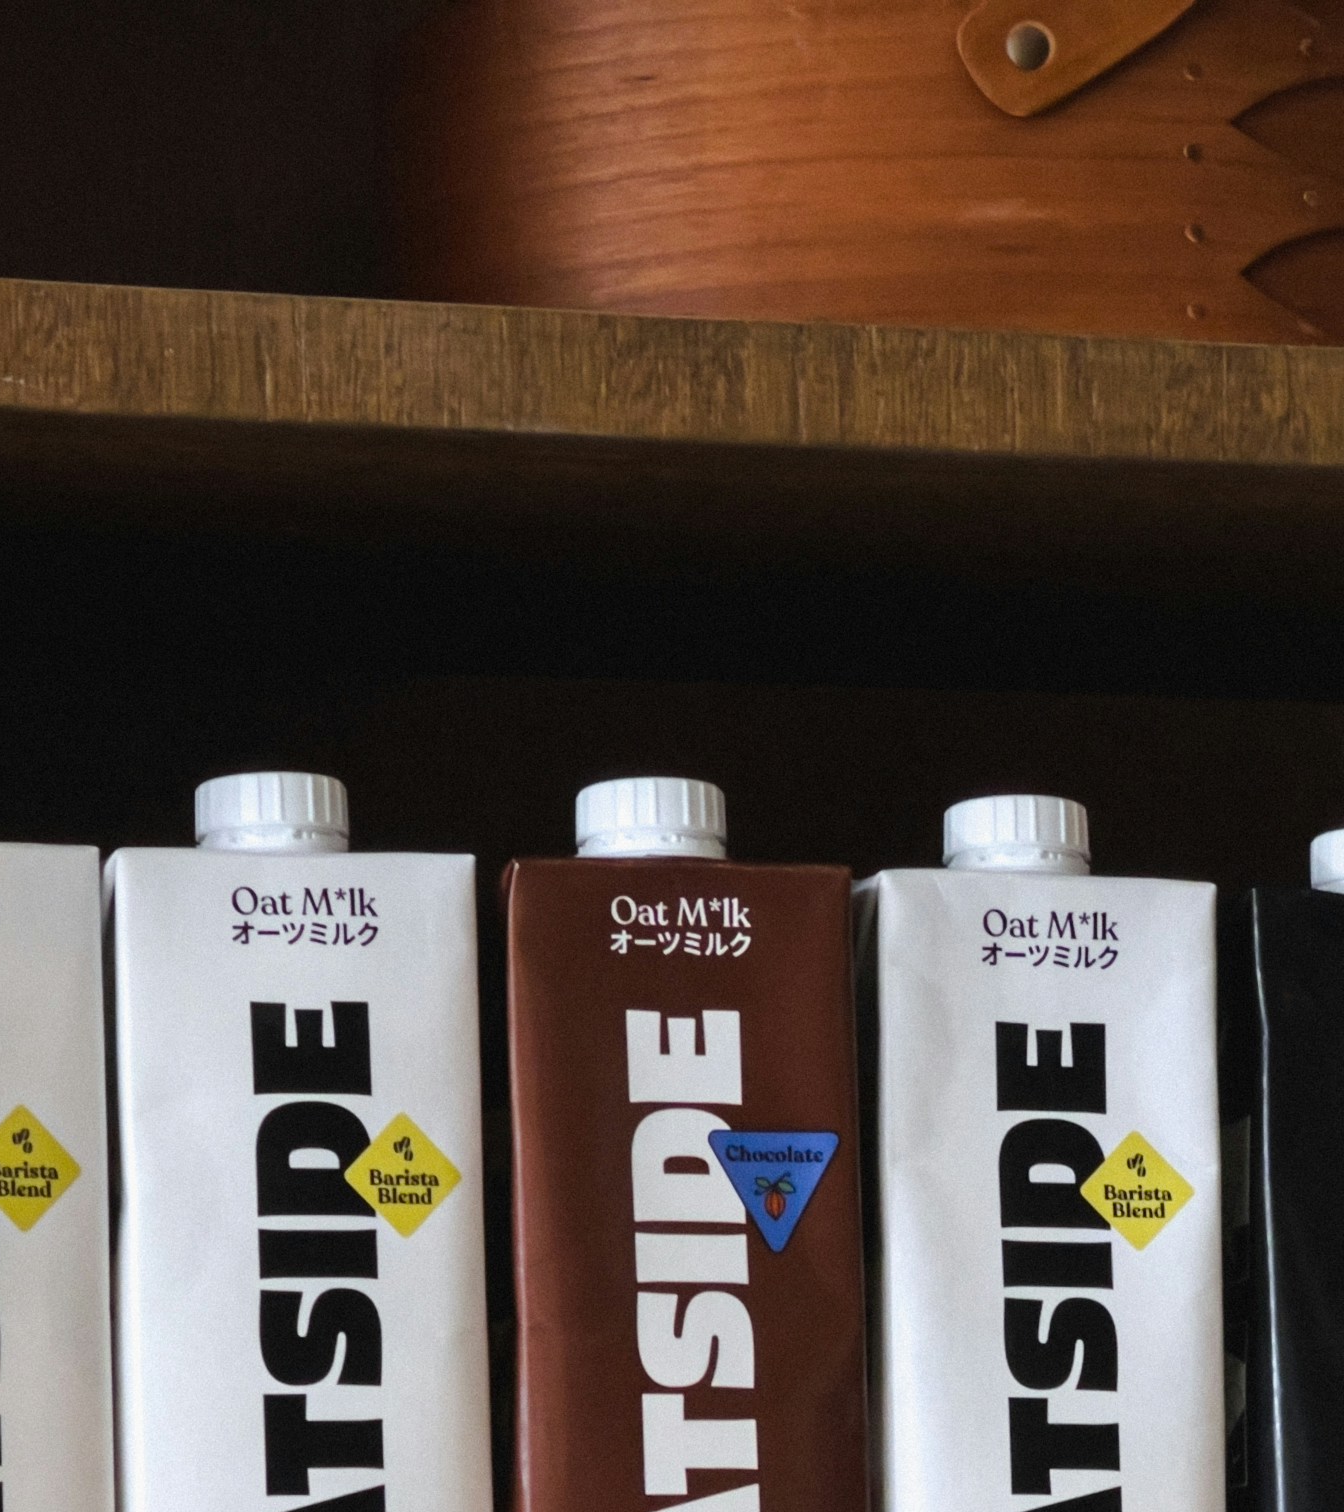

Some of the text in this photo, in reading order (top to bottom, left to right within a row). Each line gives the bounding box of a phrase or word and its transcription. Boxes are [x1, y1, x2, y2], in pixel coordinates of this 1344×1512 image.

[231, 886, 293, 916] Oat
[610, 895, 669, 927] Oat
[232, 920, 379, 947] オーツミルク
[982, 908, 1039, 939] Oat
[610, 929, 752, 958] オーツミルク
[981, 942, 1119, 970] オーツミルク
[724, 1143, 823, 1164] Chocolate
[369, 1168, 440, 1187] Barista
[377, 1187, 433, 1205] Blend
[1103, 1184, 1173, 1202] Barista
[1112, 1201, 1166, 1219] Blend
